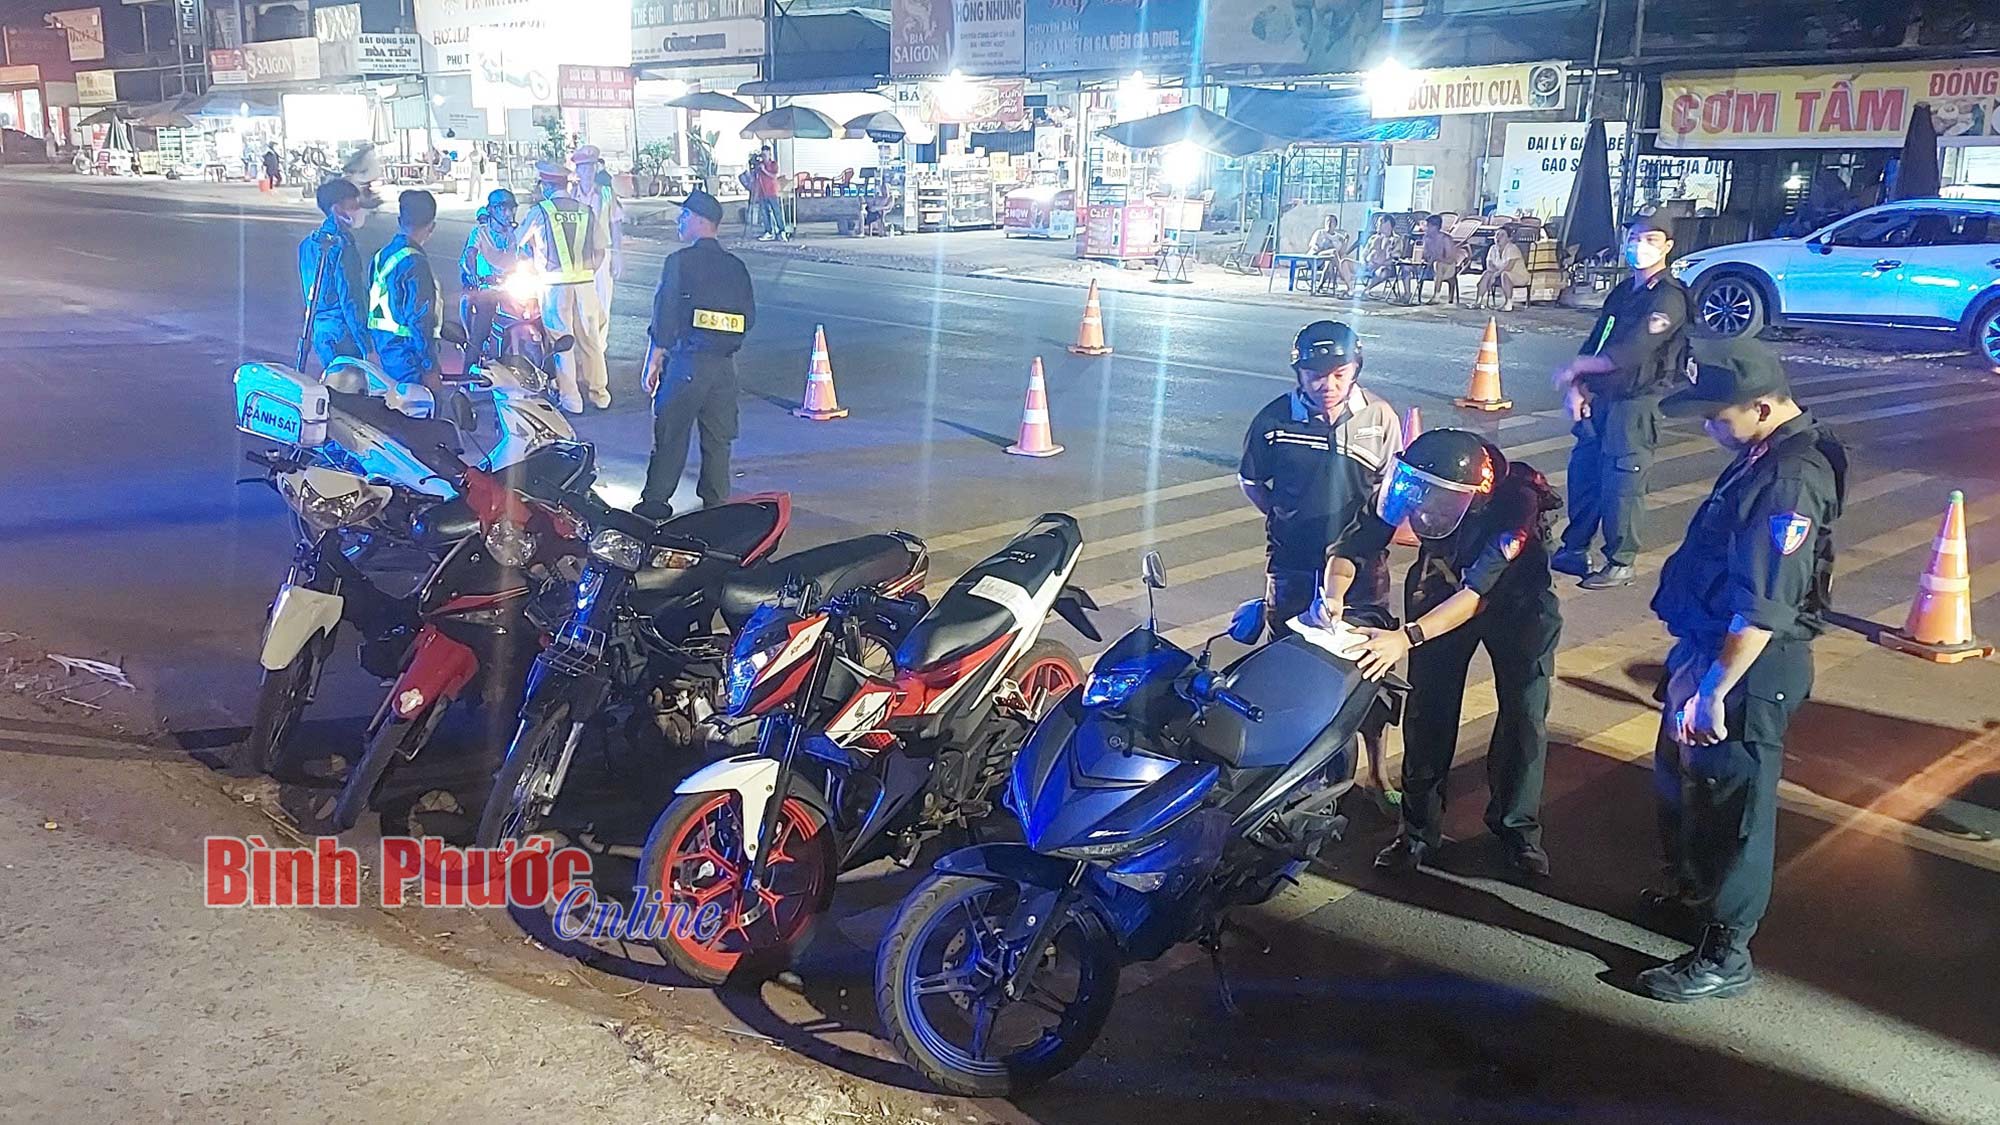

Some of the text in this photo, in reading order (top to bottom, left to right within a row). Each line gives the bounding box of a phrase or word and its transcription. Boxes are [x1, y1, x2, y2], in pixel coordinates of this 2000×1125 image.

[985, 0, 1022, 21] NHUNG
[909, 33, 924, 45] BIA
[894, 45, 940, 63] SAIGON
[256, 55, 292, 75] SAIGON
[1445, 76, 1485, 108] RIÊU
[1488, 80, 1523, 105] CUA
[1671, 89, 1778, 134] CƠM
[1527, 136, 1549, 154] ĐẠI
[1552, 133, 1568, 151] LÝ
[1541, 158, 1567, 175] GẠO
[554, 212, 583, 222] CSGT
[245, 405, 297, 434] CẢNH SÁT
